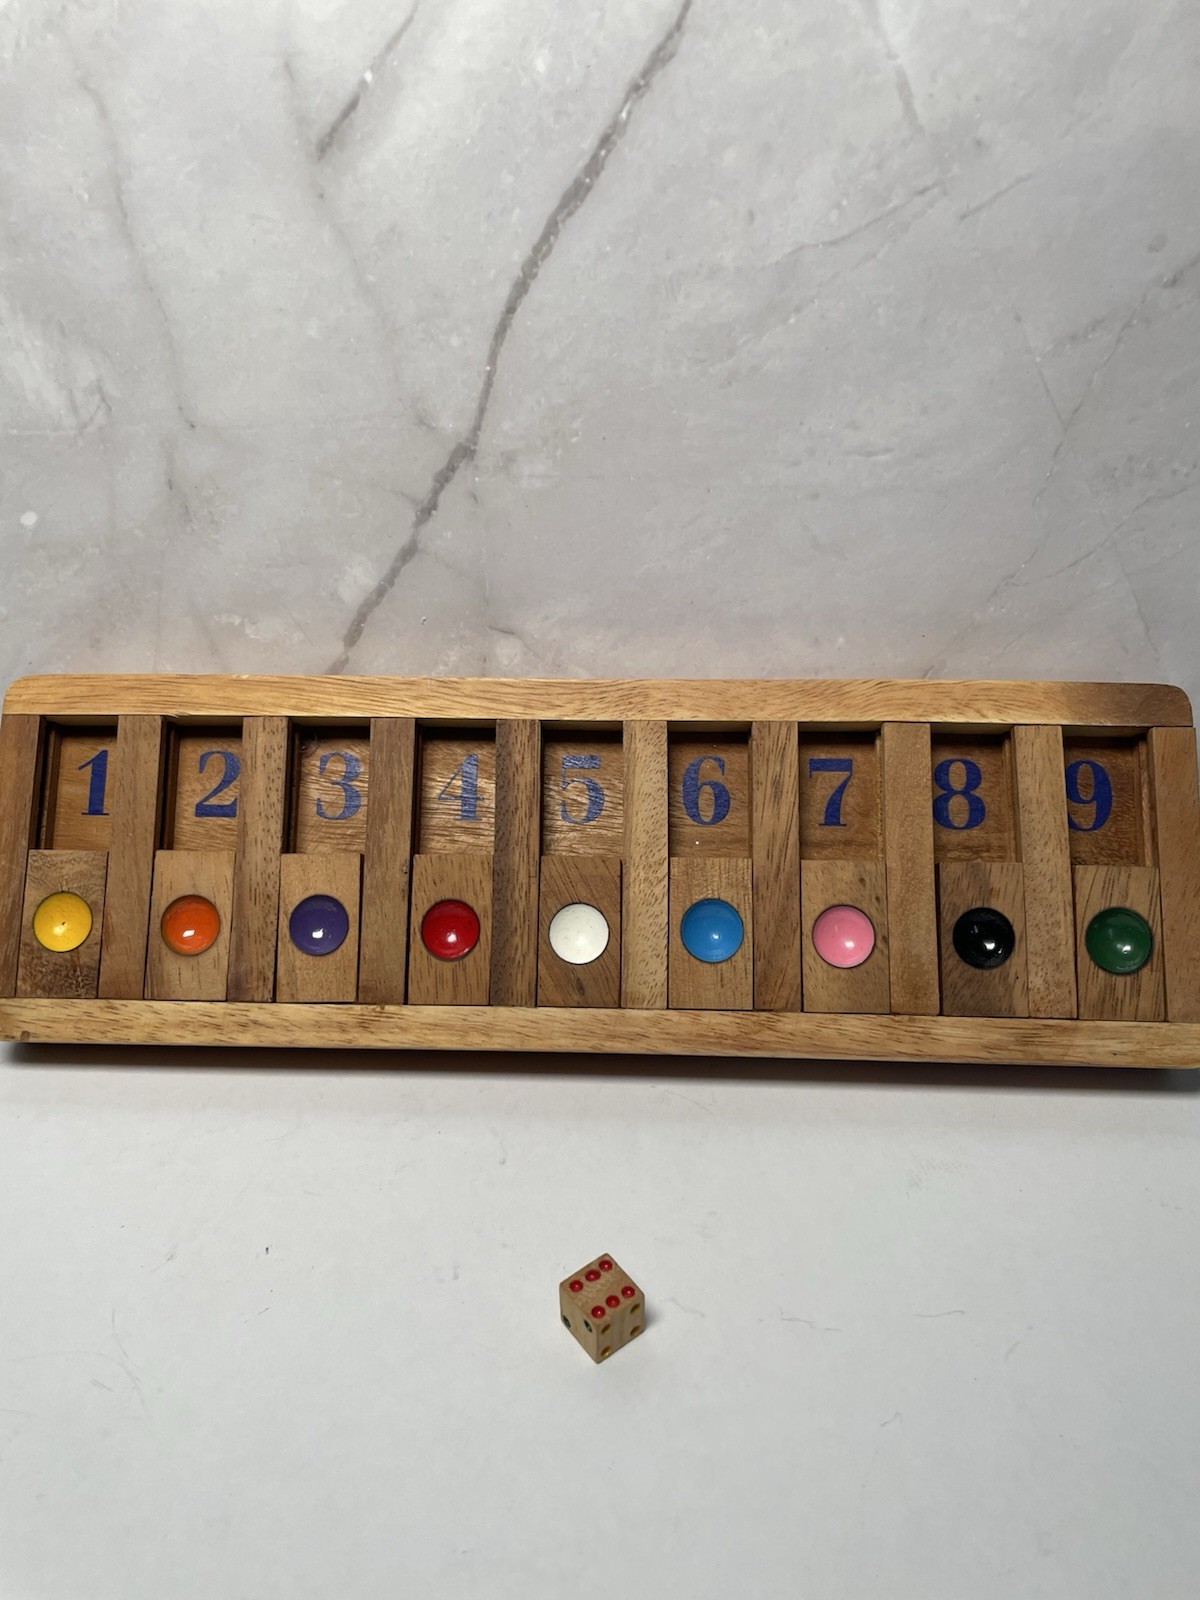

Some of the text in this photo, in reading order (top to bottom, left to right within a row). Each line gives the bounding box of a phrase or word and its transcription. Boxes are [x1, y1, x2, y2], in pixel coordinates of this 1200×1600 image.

[77, 749, 110, 816] 1
[194, 750, 242, 818] 2
[316, 751, 363, 821] 3
[437, 753, 484, 821] 4
[560, 755, 605, 824] 5
[682, 755, 731, 826] 6
[808, 758, 853, 827] 7
[933, 758, 986, 830] 8
[1066, 759, 1113, 832] 9
